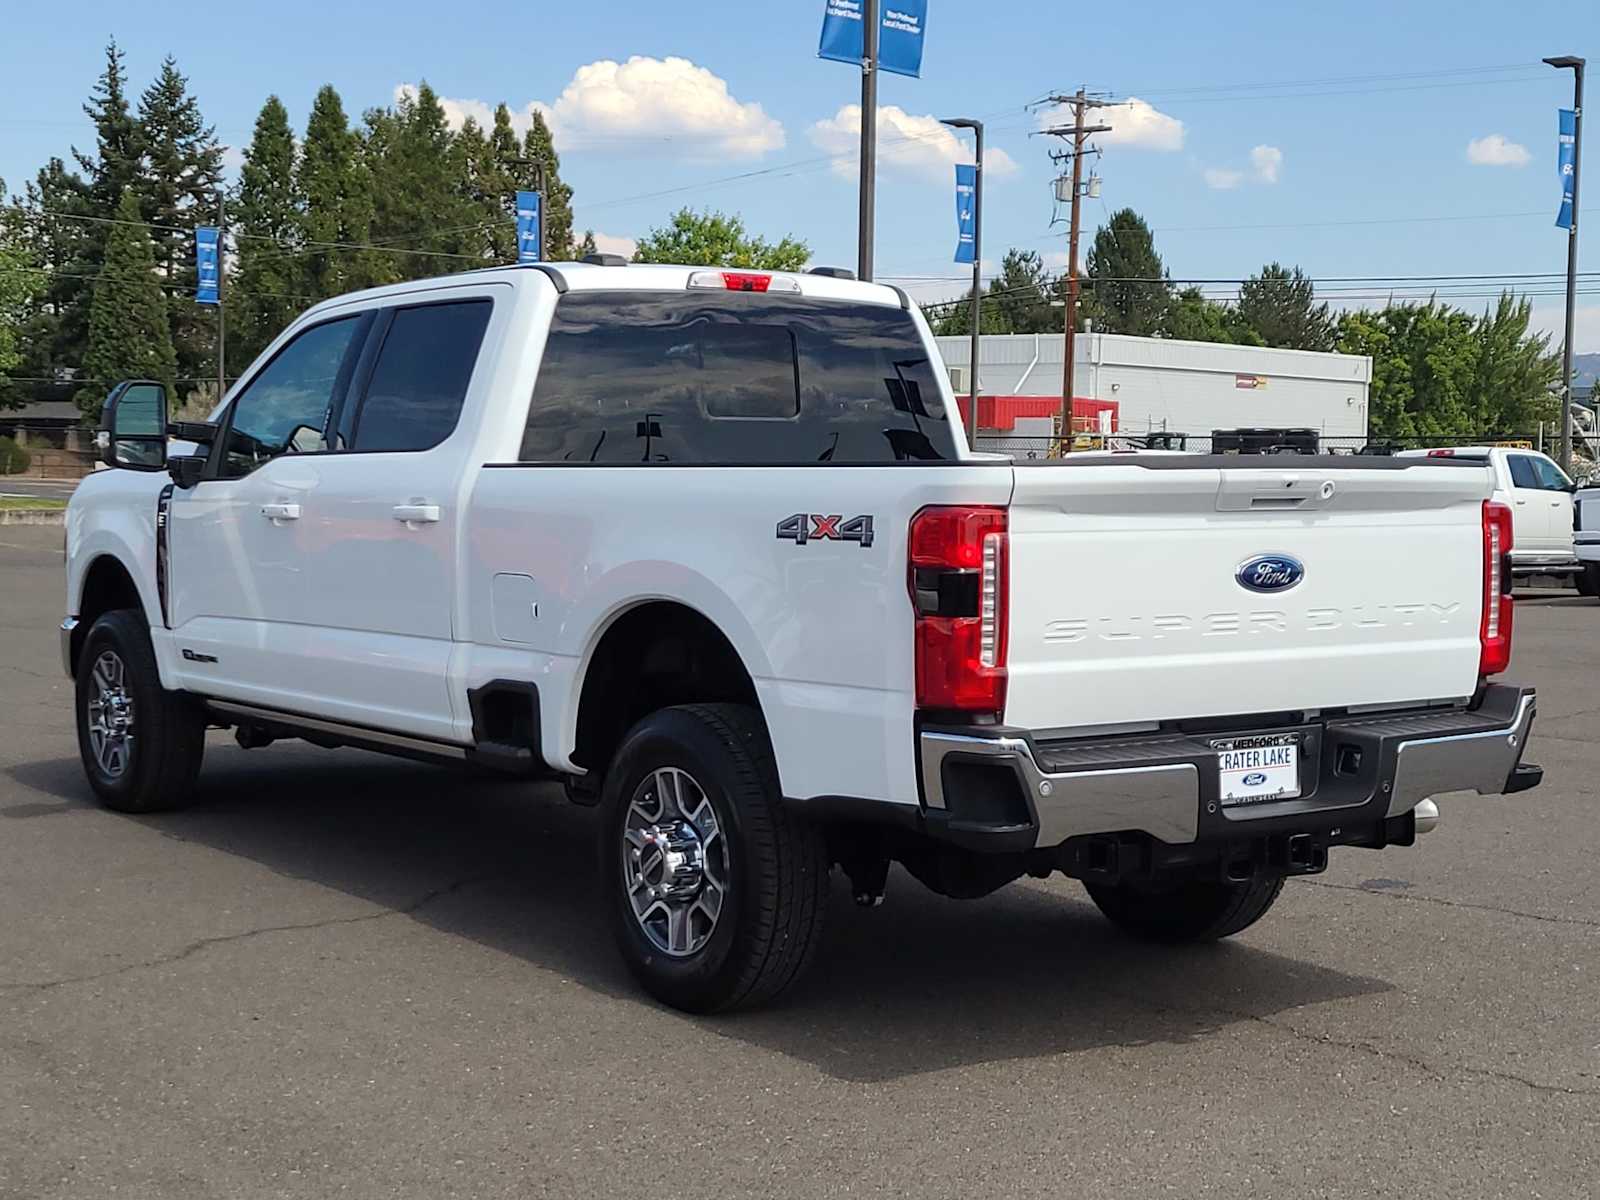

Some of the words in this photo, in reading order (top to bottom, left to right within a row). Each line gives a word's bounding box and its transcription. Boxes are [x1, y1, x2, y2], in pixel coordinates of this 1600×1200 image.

[1254, 561, 1292, 584] Ford
[1043, 609, 1286, 644] SUPER
[1306, 601, 1461, 632] DUTY
[1233, 736, 1279, 749] MEDFORD
[1264, 747, 1291, 765] LAKE
[1245, 773, 1265, 785] Ford
